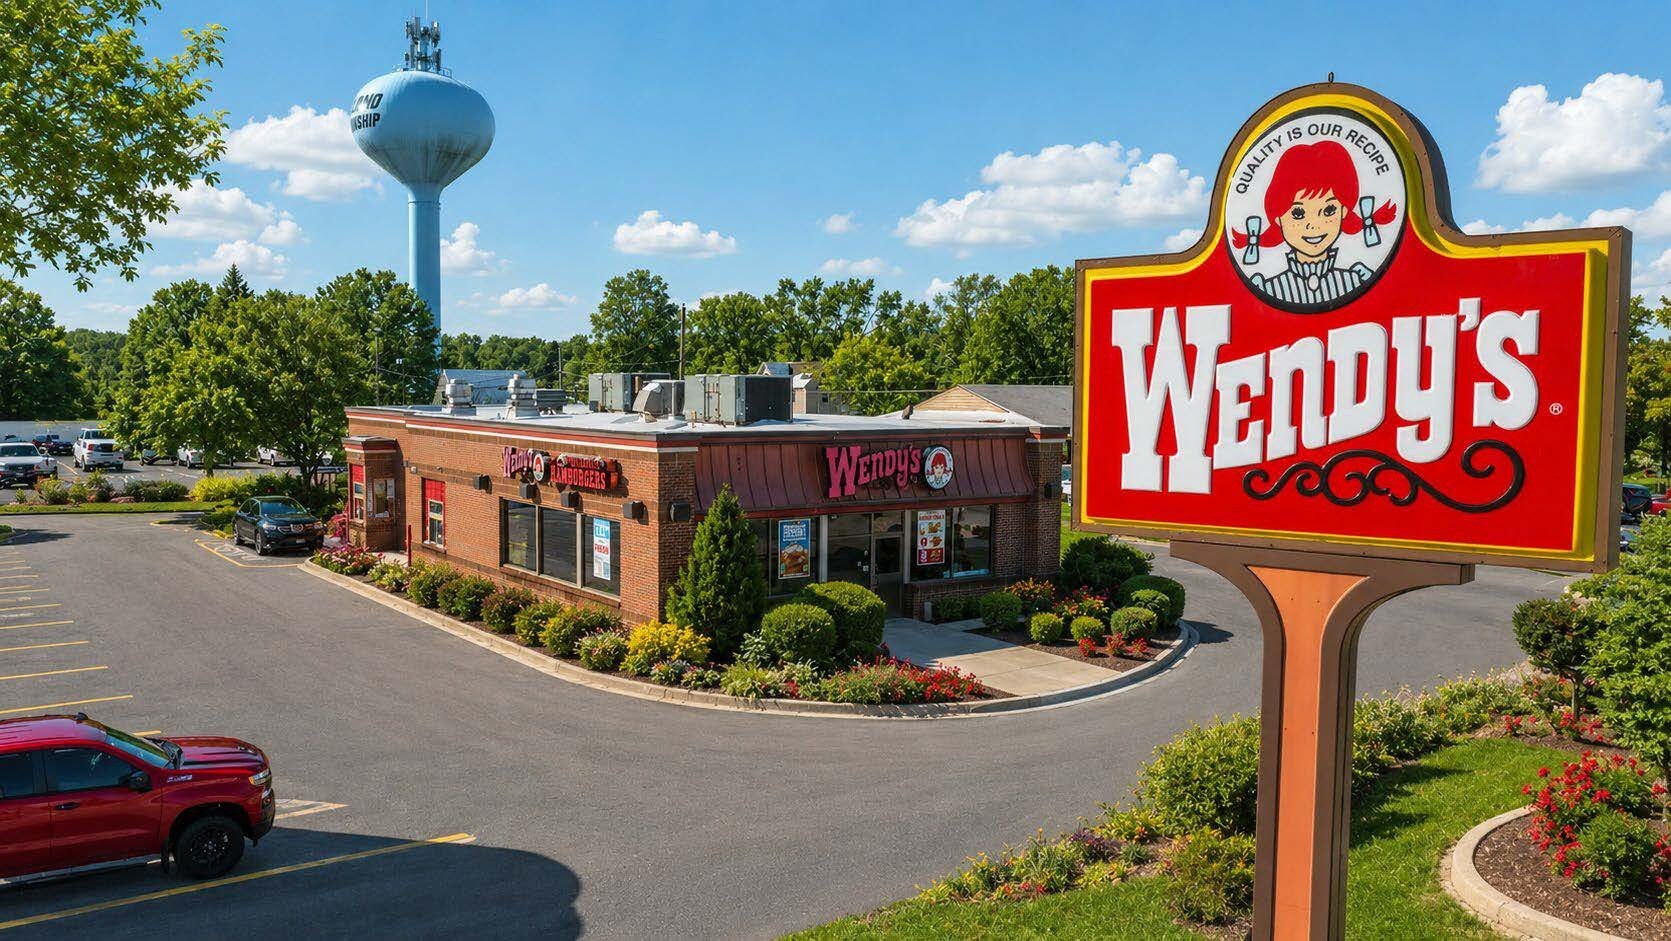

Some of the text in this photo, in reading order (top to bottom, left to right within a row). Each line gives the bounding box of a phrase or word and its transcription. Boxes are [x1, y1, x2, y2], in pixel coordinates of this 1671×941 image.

[1235, 123, 1390, 194] QUALITY IS OUR RECIPE
[550, 464, 606, 490] HAMBURGERS
